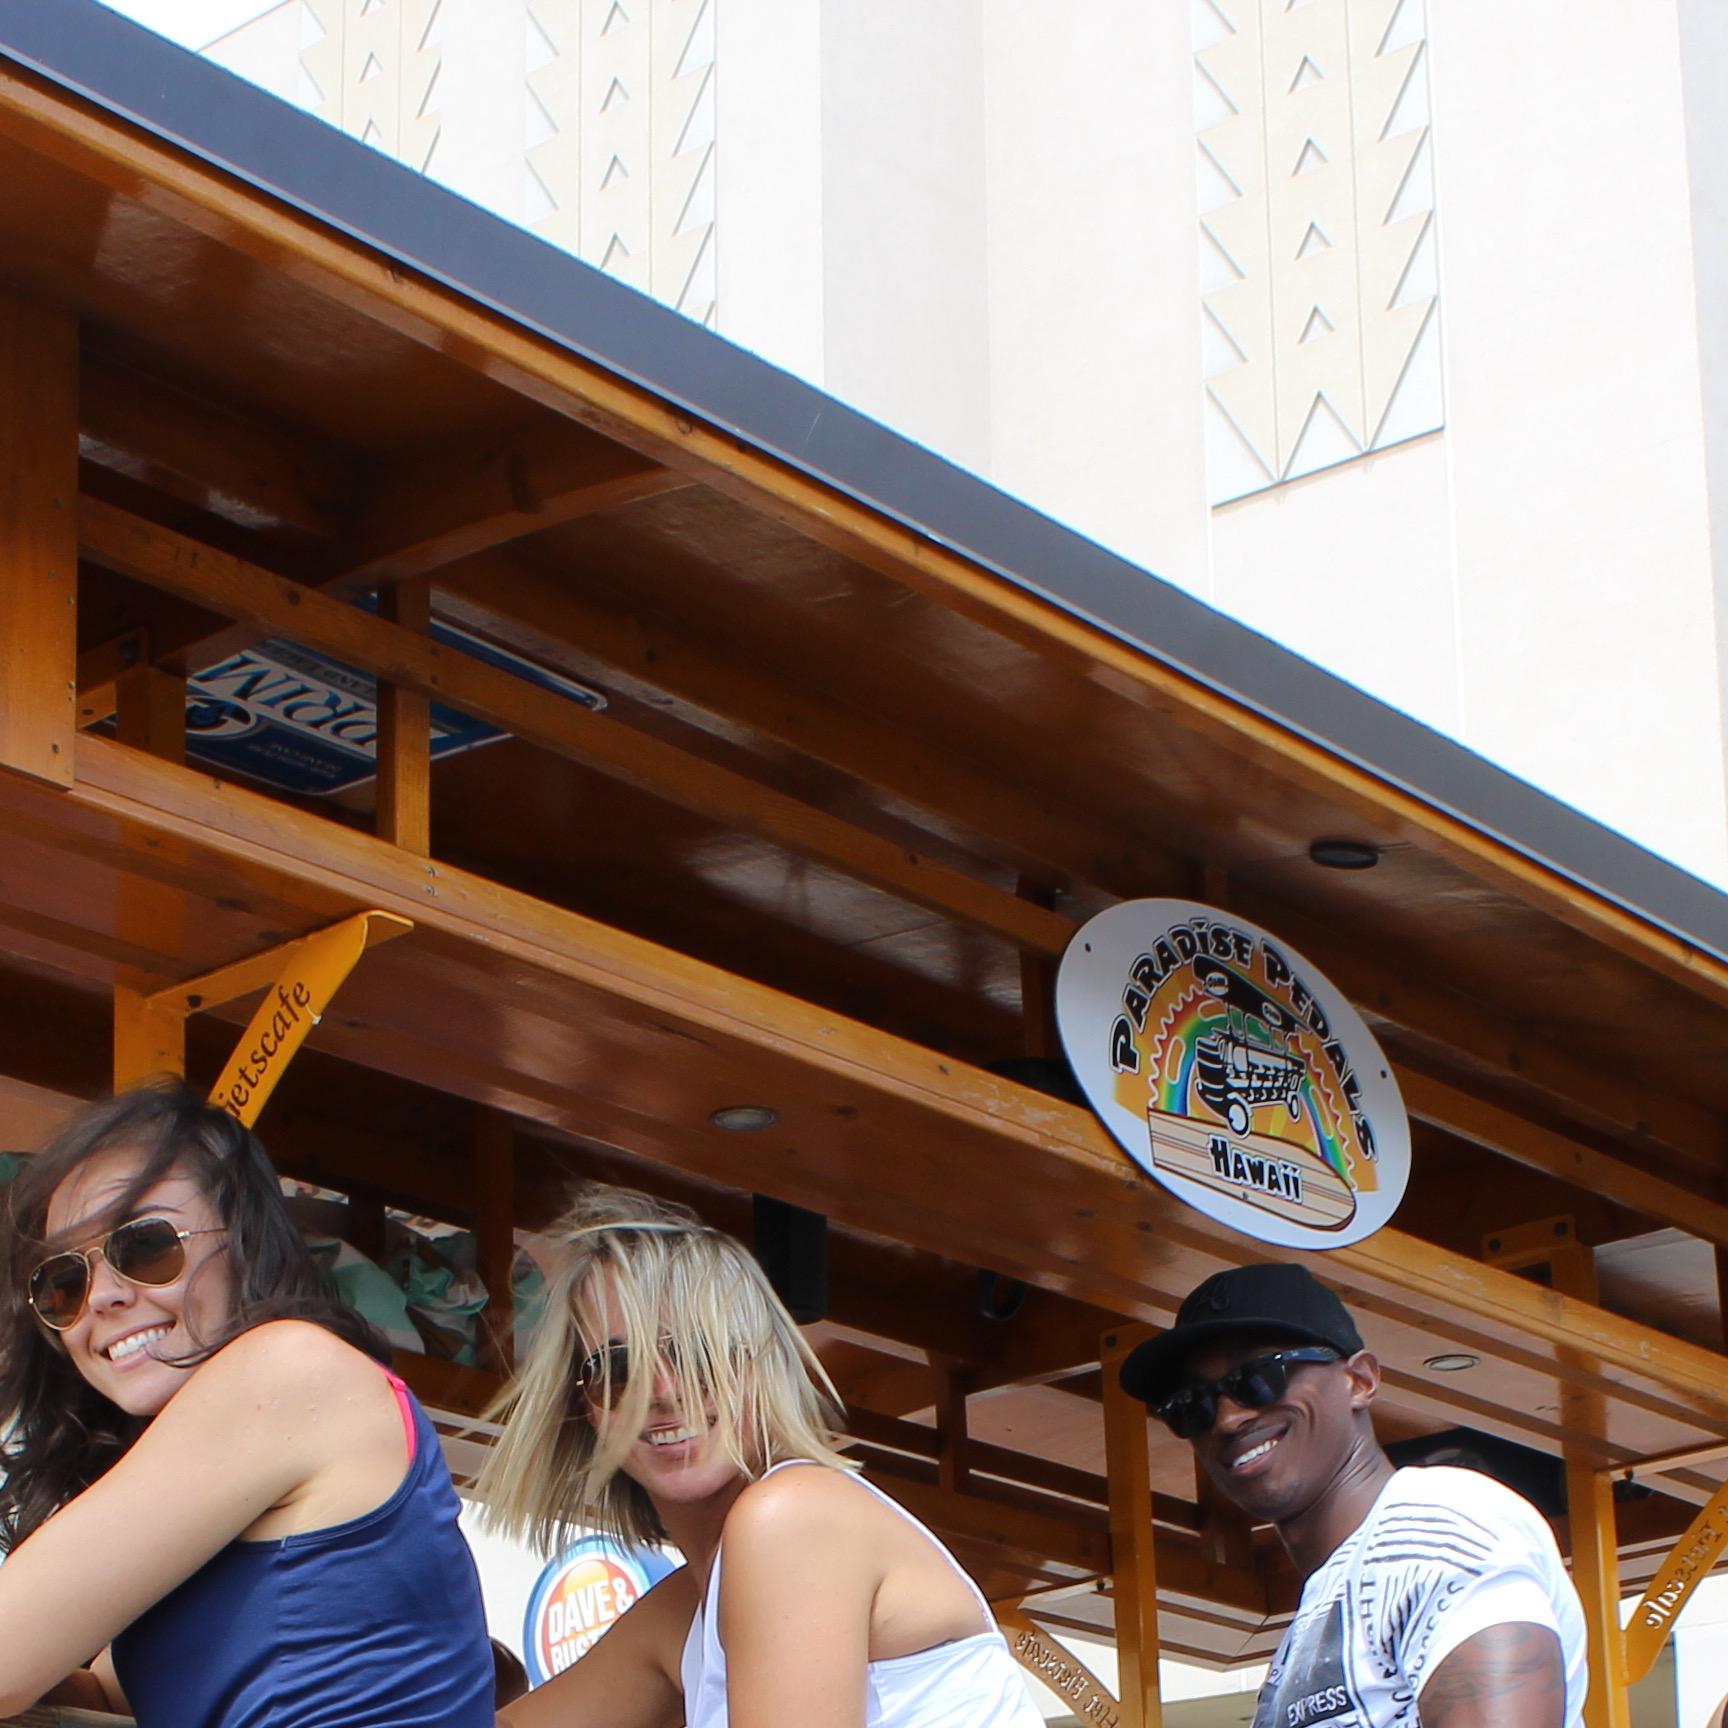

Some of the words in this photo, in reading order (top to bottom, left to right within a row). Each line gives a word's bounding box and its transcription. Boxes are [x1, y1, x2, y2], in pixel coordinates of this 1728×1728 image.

[191, 653, 376, 746] PRIM
[218, 982, 311, 1118] ietscafe
[1110, 919, 1254, 1073] PARADISE
[1260, 939, 1376, 1161] PEDALS
[1208, 1134, 1302, 1204] HAWAII
[548, 1580, 614, 1644] DAVE
[612, 1577, 634, 1614] &
[1286, 1684, 1349, 1728] EXPRESS
